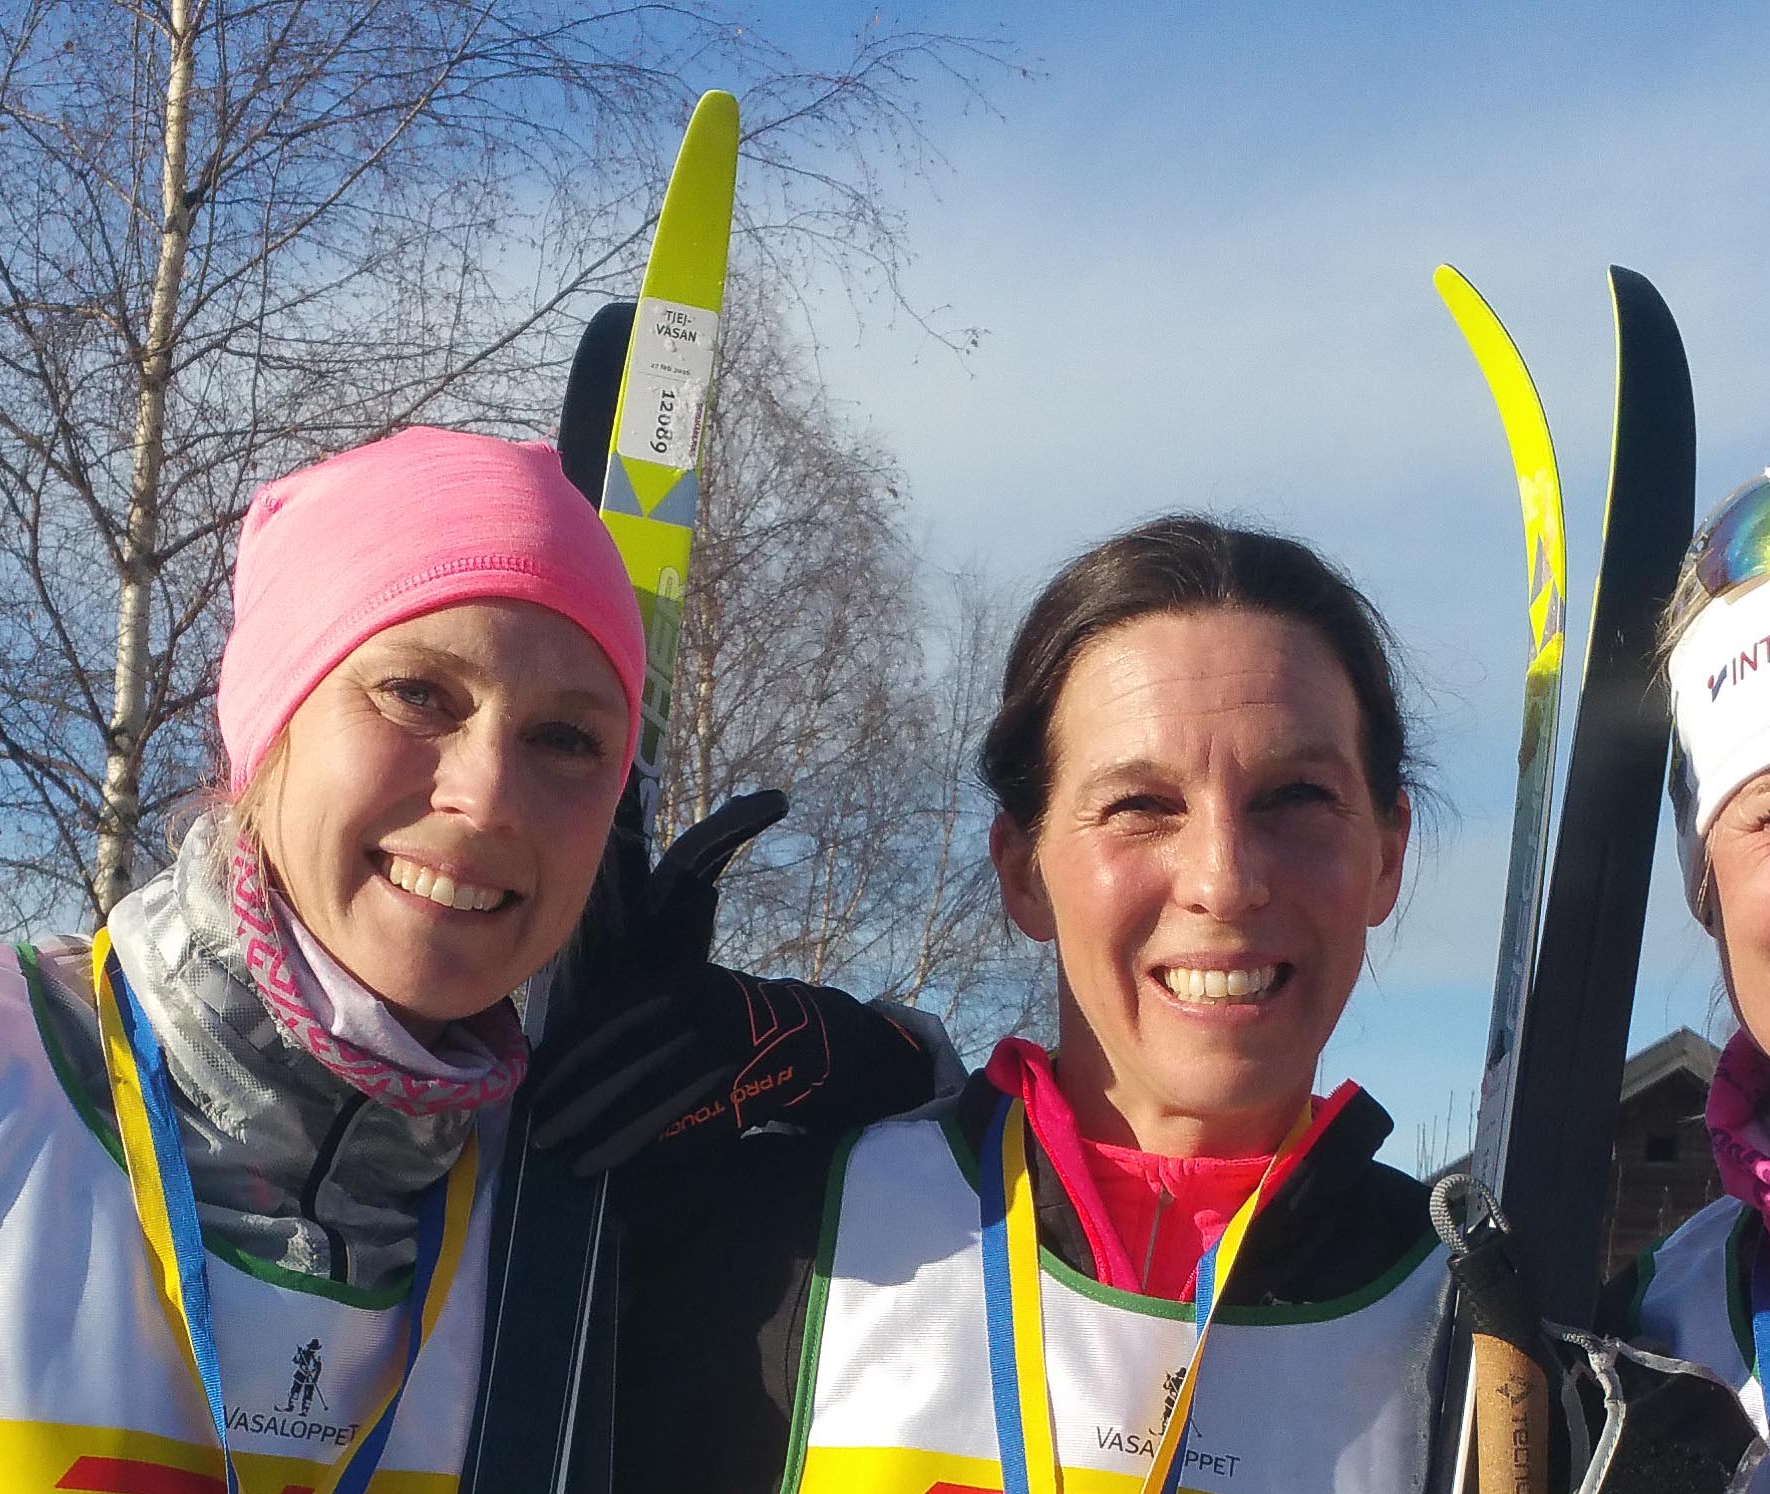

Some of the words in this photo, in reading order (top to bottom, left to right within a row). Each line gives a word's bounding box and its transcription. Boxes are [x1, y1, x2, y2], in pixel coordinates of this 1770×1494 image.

[656, 324, 697, 343] VASAN
[666, 310, 692, 327] TJEJ-
[649, 389, 676, 454] 12089
[223, 1404, 360, 1447] VASALOPPET
[1096, 1426, 1241, 1478] VASAPPET
